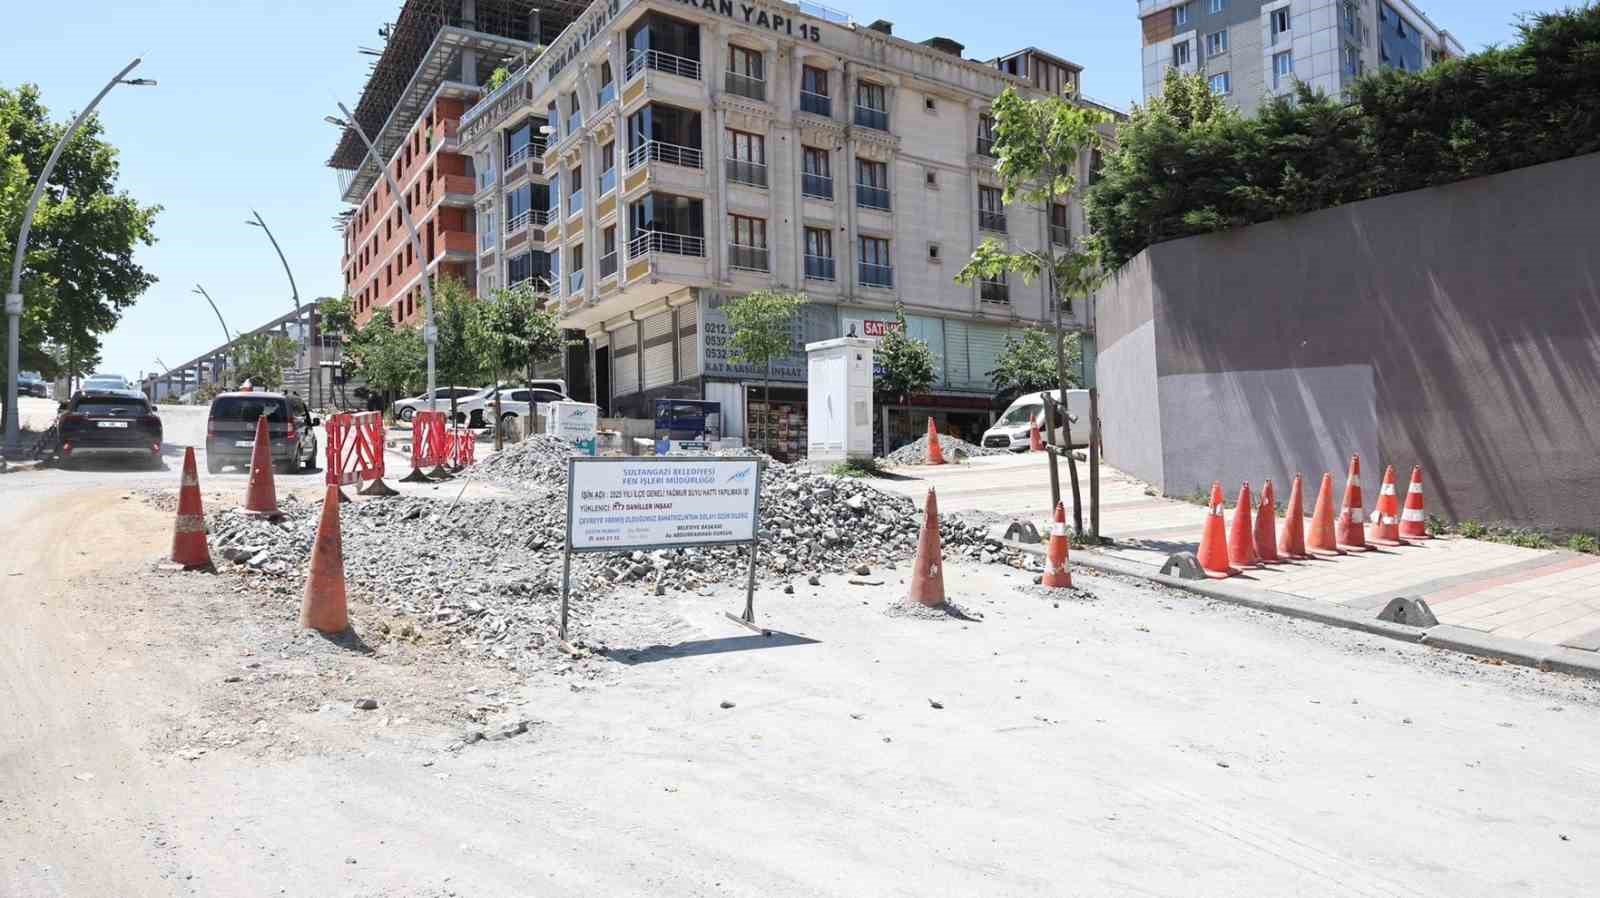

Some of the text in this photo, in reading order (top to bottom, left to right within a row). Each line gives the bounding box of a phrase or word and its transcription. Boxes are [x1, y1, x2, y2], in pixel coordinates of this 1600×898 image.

[741, 4, 792, 35] YAPI
[800, 23, 821, 43] 15
[704, 322, 727, 335] 0212
